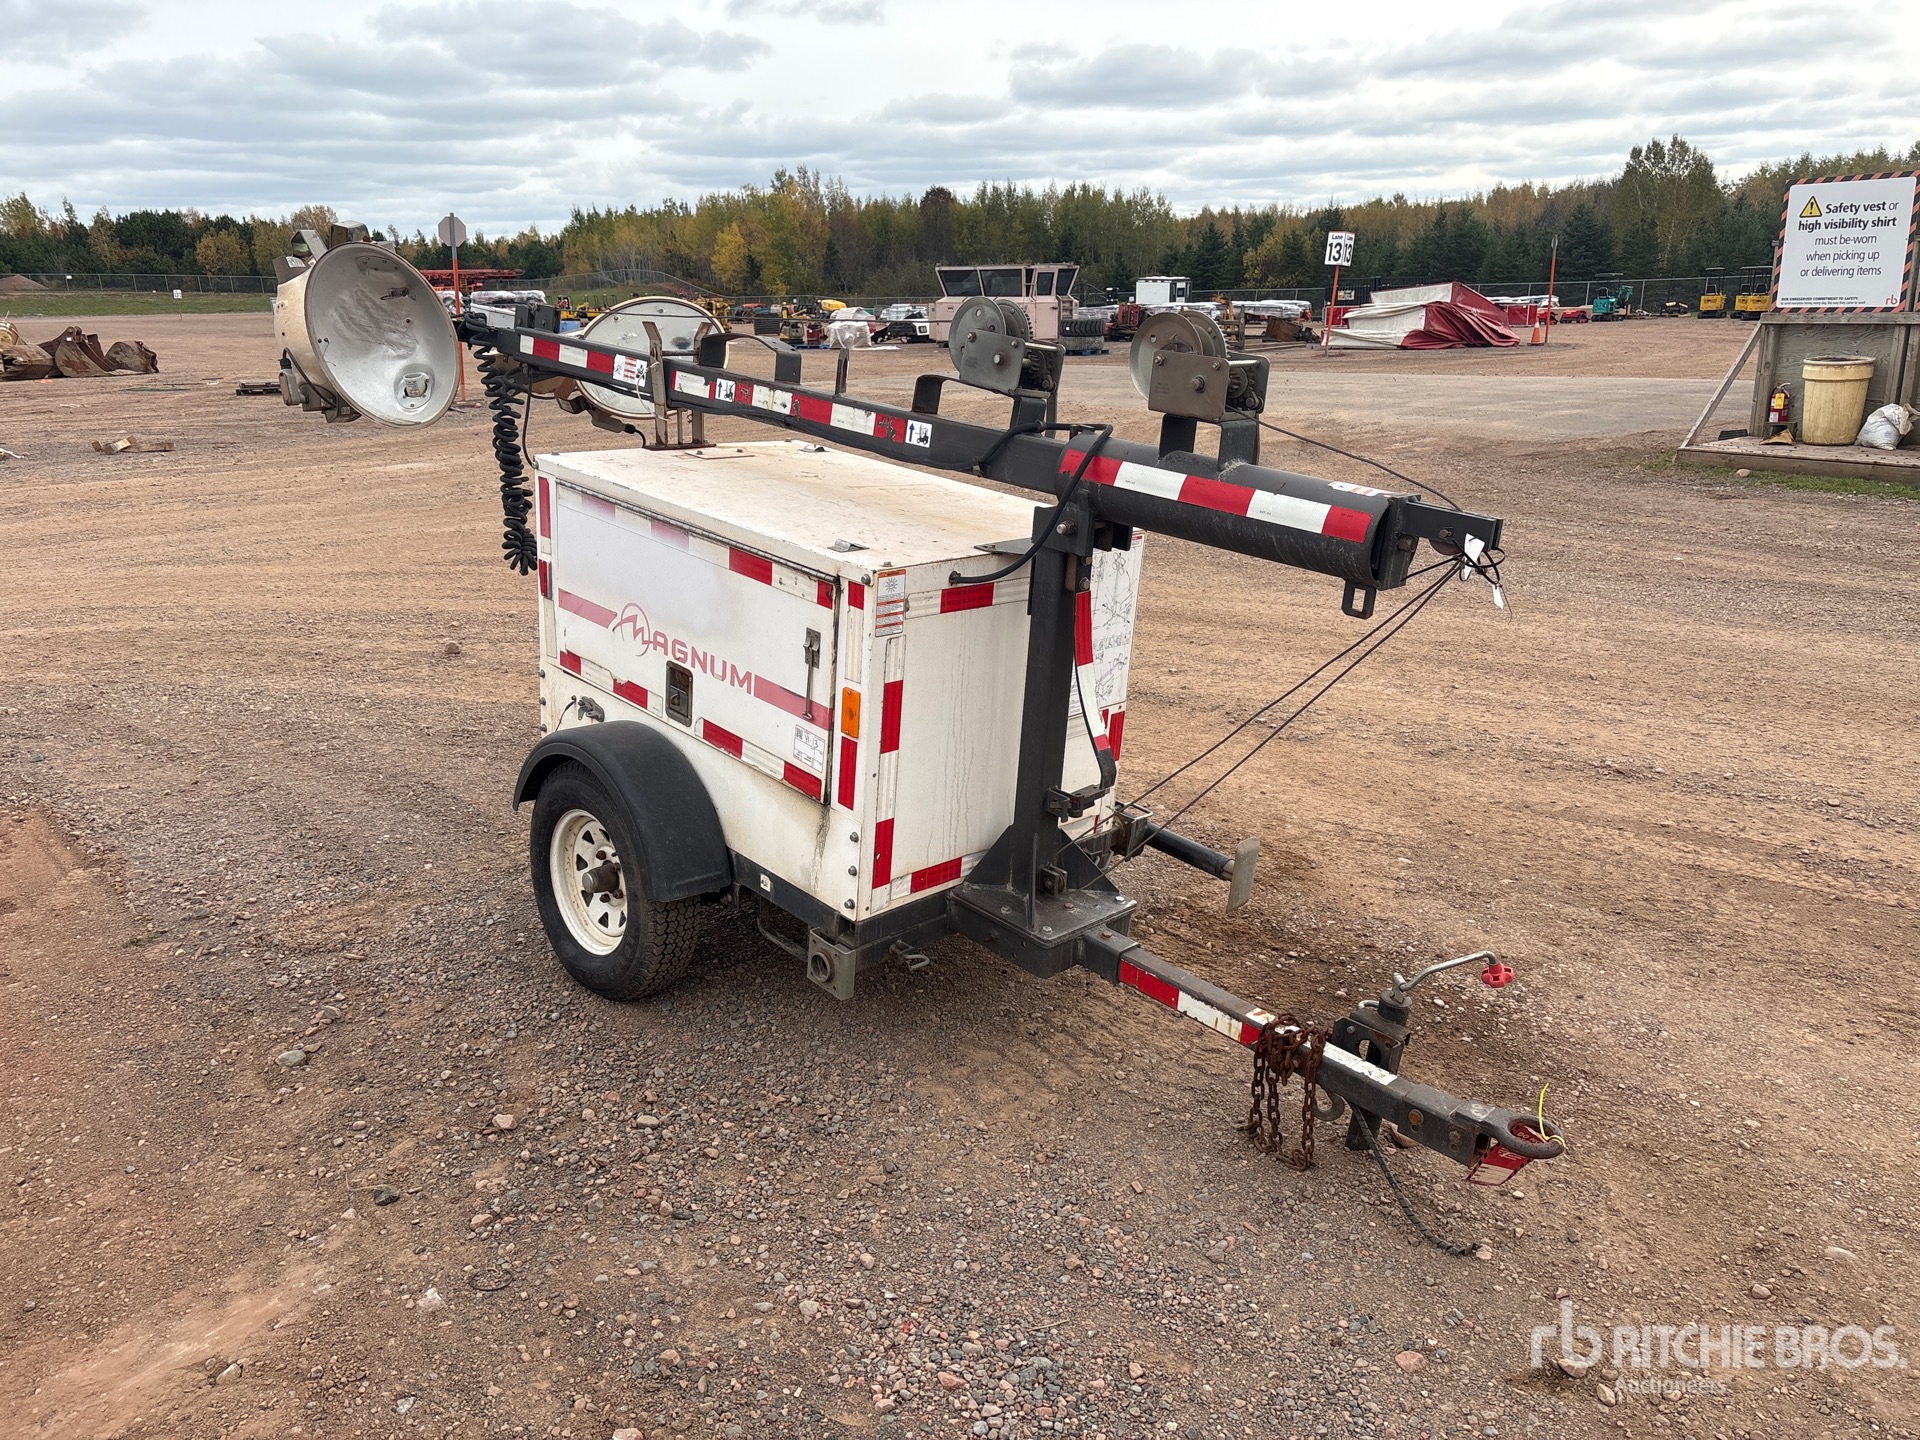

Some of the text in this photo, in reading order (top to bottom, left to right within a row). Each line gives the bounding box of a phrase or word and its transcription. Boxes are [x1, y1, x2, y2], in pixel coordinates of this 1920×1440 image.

[1825, 201, 1899, 215] Safety vest or
[1798, 216, 1897, 233] high visibility shirt
[1814, 236, 1837, 246] must
[1328, 242, 1342, 262] 13
[1343, 243, 1353, 263] 13
[1806, 249, 1880, 263] when picking up
[1800, 265, 1882, 278] or delivering items
[1885, 294, 1898, 306] rb
[612, 602, 753, 696] MAGNUM
